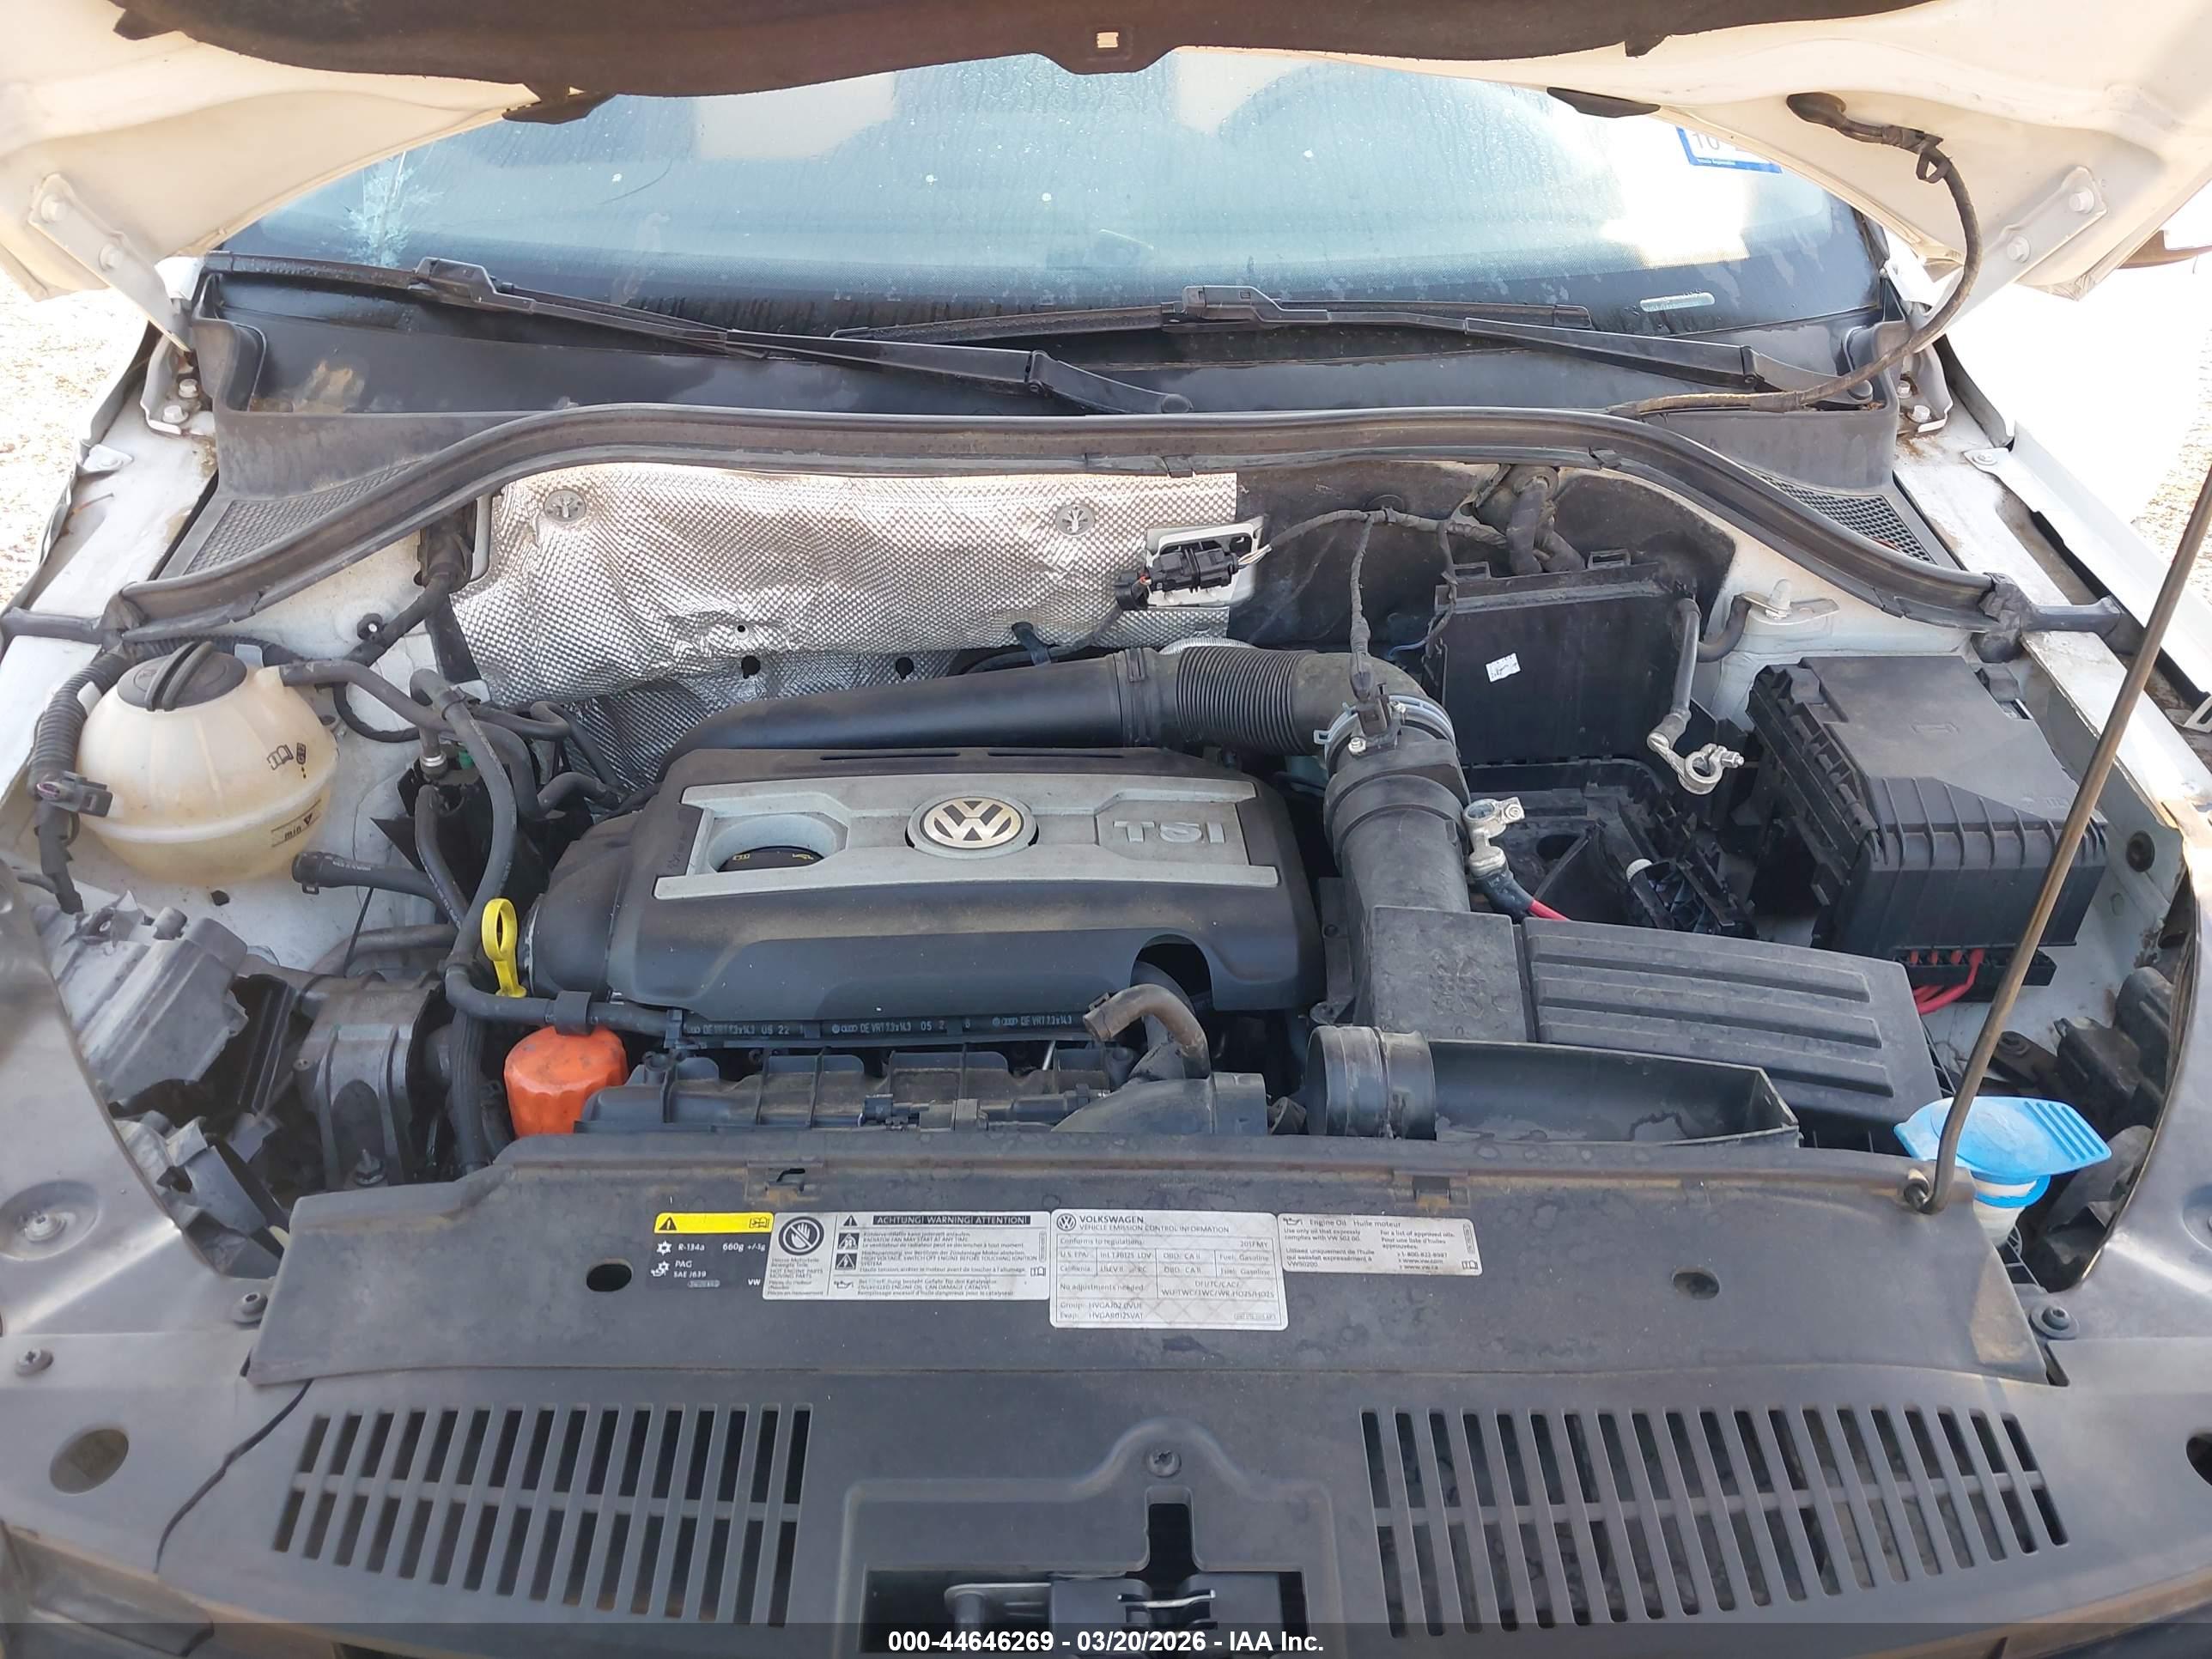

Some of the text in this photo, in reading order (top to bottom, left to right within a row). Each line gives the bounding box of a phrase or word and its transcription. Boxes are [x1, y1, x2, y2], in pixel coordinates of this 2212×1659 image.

[284, 825, 301, 842] min
[1114, 819, 1226, 845] TSI
[921, 1021, 933, 1031] 05
[877, 1215, 1027, 1224] ACHTUNG! WARNING! ATTENTION!
[1310, 1218, 1334, 1227] Engine
